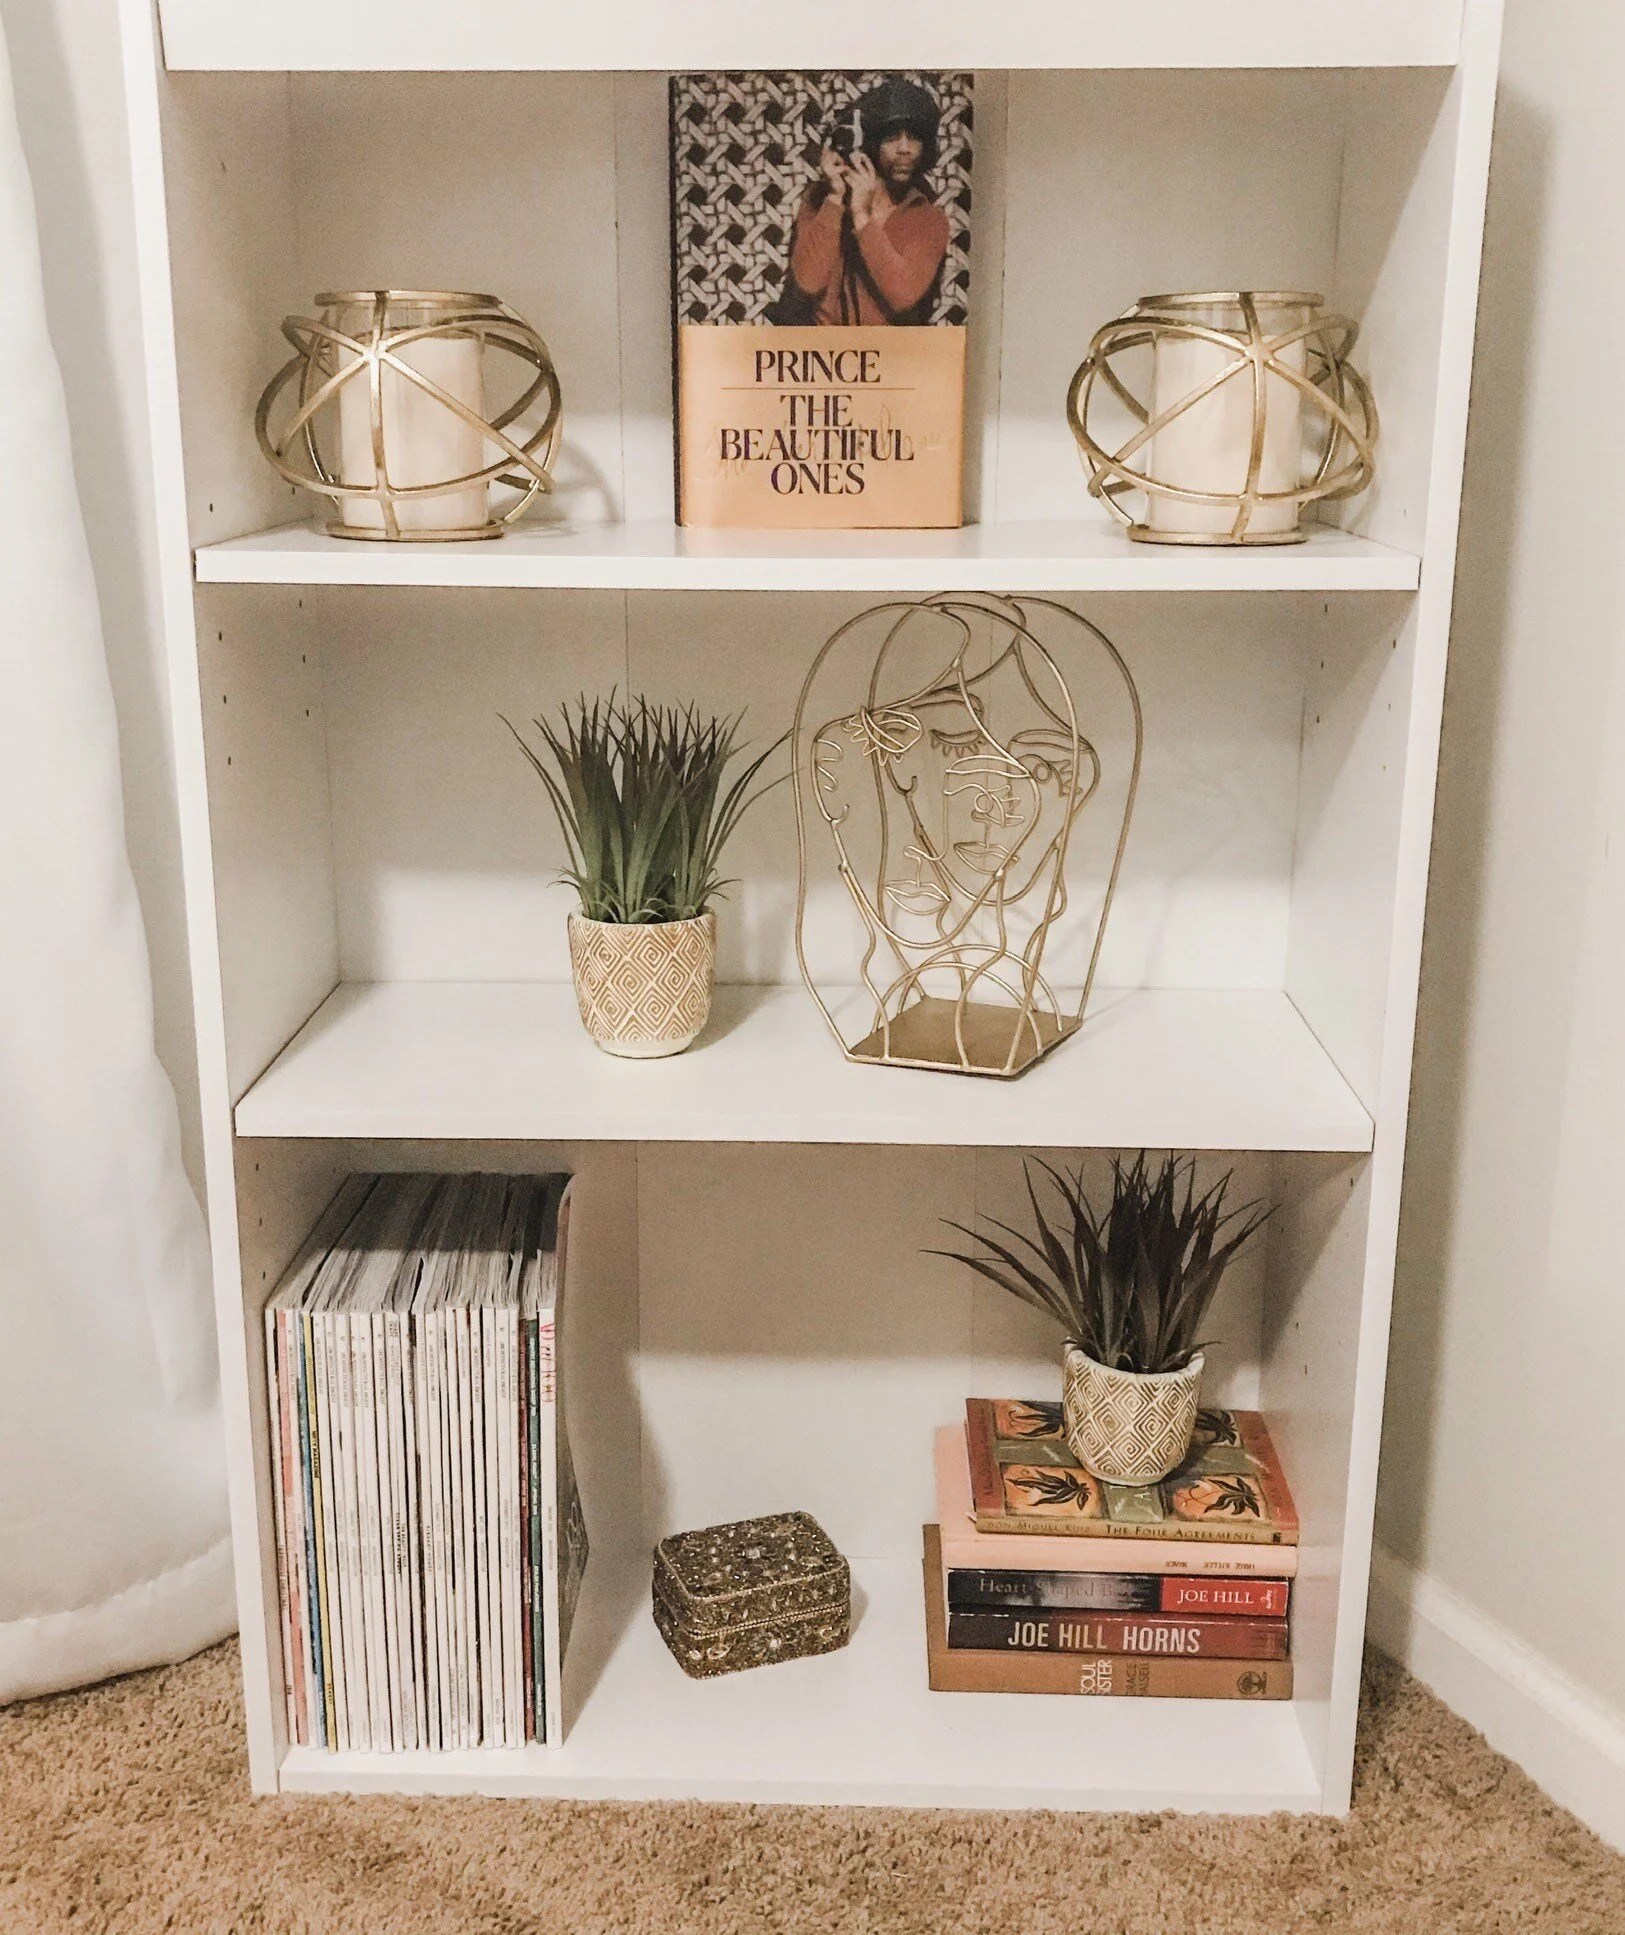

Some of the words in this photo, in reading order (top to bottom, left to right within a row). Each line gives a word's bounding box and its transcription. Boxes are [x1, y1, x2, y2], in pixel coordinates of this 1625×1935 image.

[755, 350, 881, 383] PRINCE
[780, 395, 852, 427] THE
[720, 429, 914, 461] BEAUTIFUL
[771, 462, 865, 495] ONES
[1105, 1524, 1128, 1535] THE
[1135, 1526, 1168, 1537] FOUR
[1176, 1528, 1256, 1541] AGREEMENTS
[1177, 1590, 1208, 1604] JOE
[1213, 1591, 1254, 1604] HILL
[1008, 1621, 1049, 1647] JOE
[1059, 1624, 1108, 1650] HILL
[1123, 1627, 1200, 1654] HORNS
[1081, 1662, 1096, 1694] SOUL
